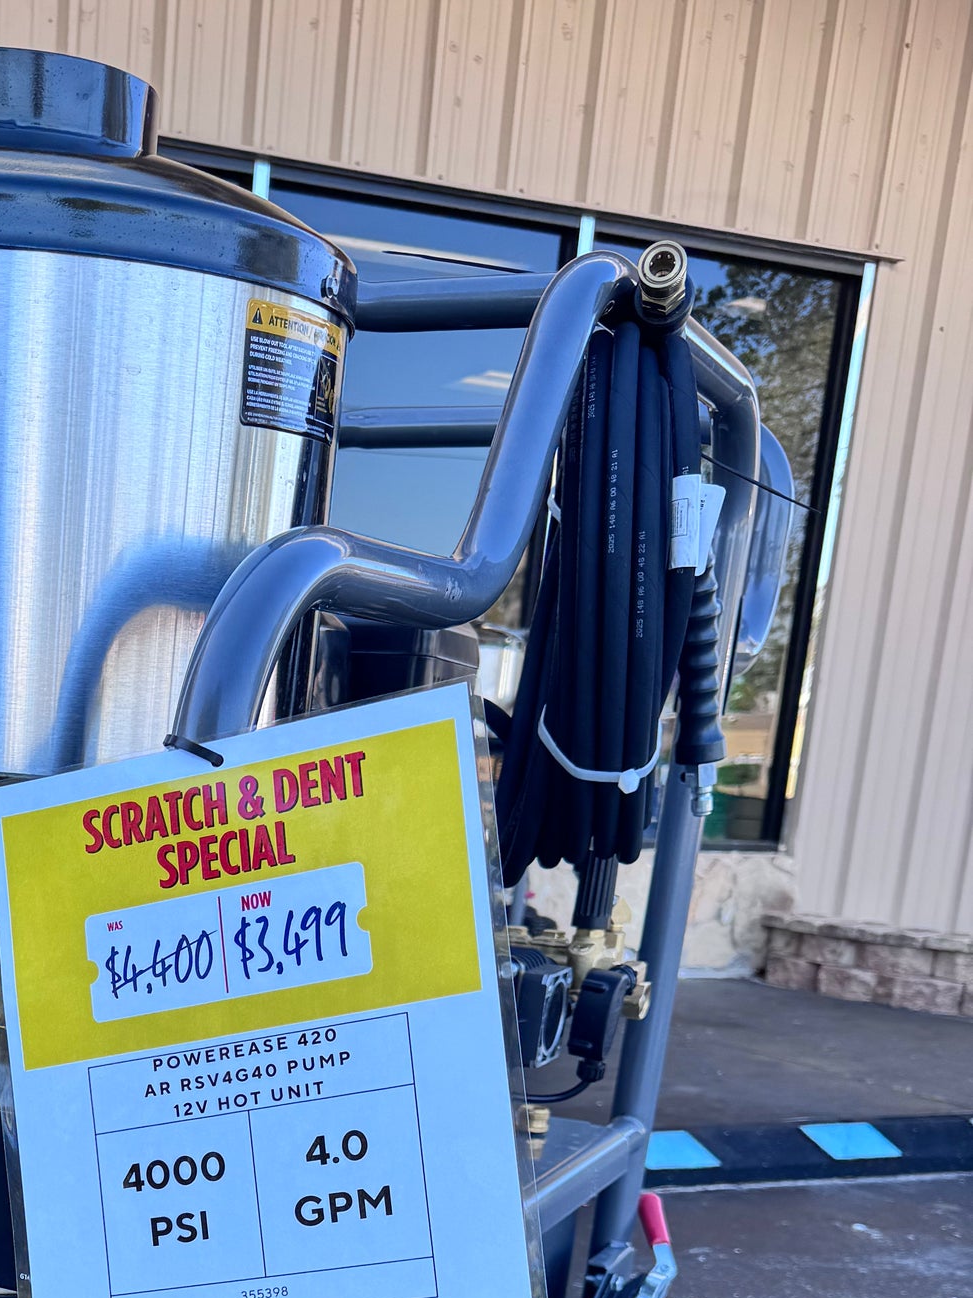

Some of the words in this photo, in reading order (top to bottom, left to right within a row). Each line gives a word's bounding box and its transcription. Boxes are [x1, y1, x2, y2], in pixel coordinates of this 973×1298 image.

[268, 315, 308, 336] ATTENTION
[635, 618, 644, 638] 2025
[82, 781, 227, 854] SCRATCH
[237, 775, 266, 822] &
[273, 750, 366, 814] DENT
[157, 820, 296, 889] SPECIAL
[240, 891, 272, 911] NOW
[106, 920, 124, 932] WAS
[234, 901, 348, 979] $3,499
[105, 930, 215, 999] $4,400
[153, 1036, 288, 1072] POWEREASE
[297, 1028, 337, 1047] 420
[144, 1081, 171, 1098] AR
[180, 1064, 277, 1092] RSV4G40
[287, 1051, 351, 1074] PUMP
[173, 1100, 208, 1118] 12V
[218, 1091, 261, 1111] HOT
[271, 1081, 324, 1102] UNIT
[305, 1129, 368, 1166] 4.0
[123, 1151, 225, 1192] 4000
[294, 1185, 393, 1227] GPM
[150, 1211, 210, 1247] PSI
